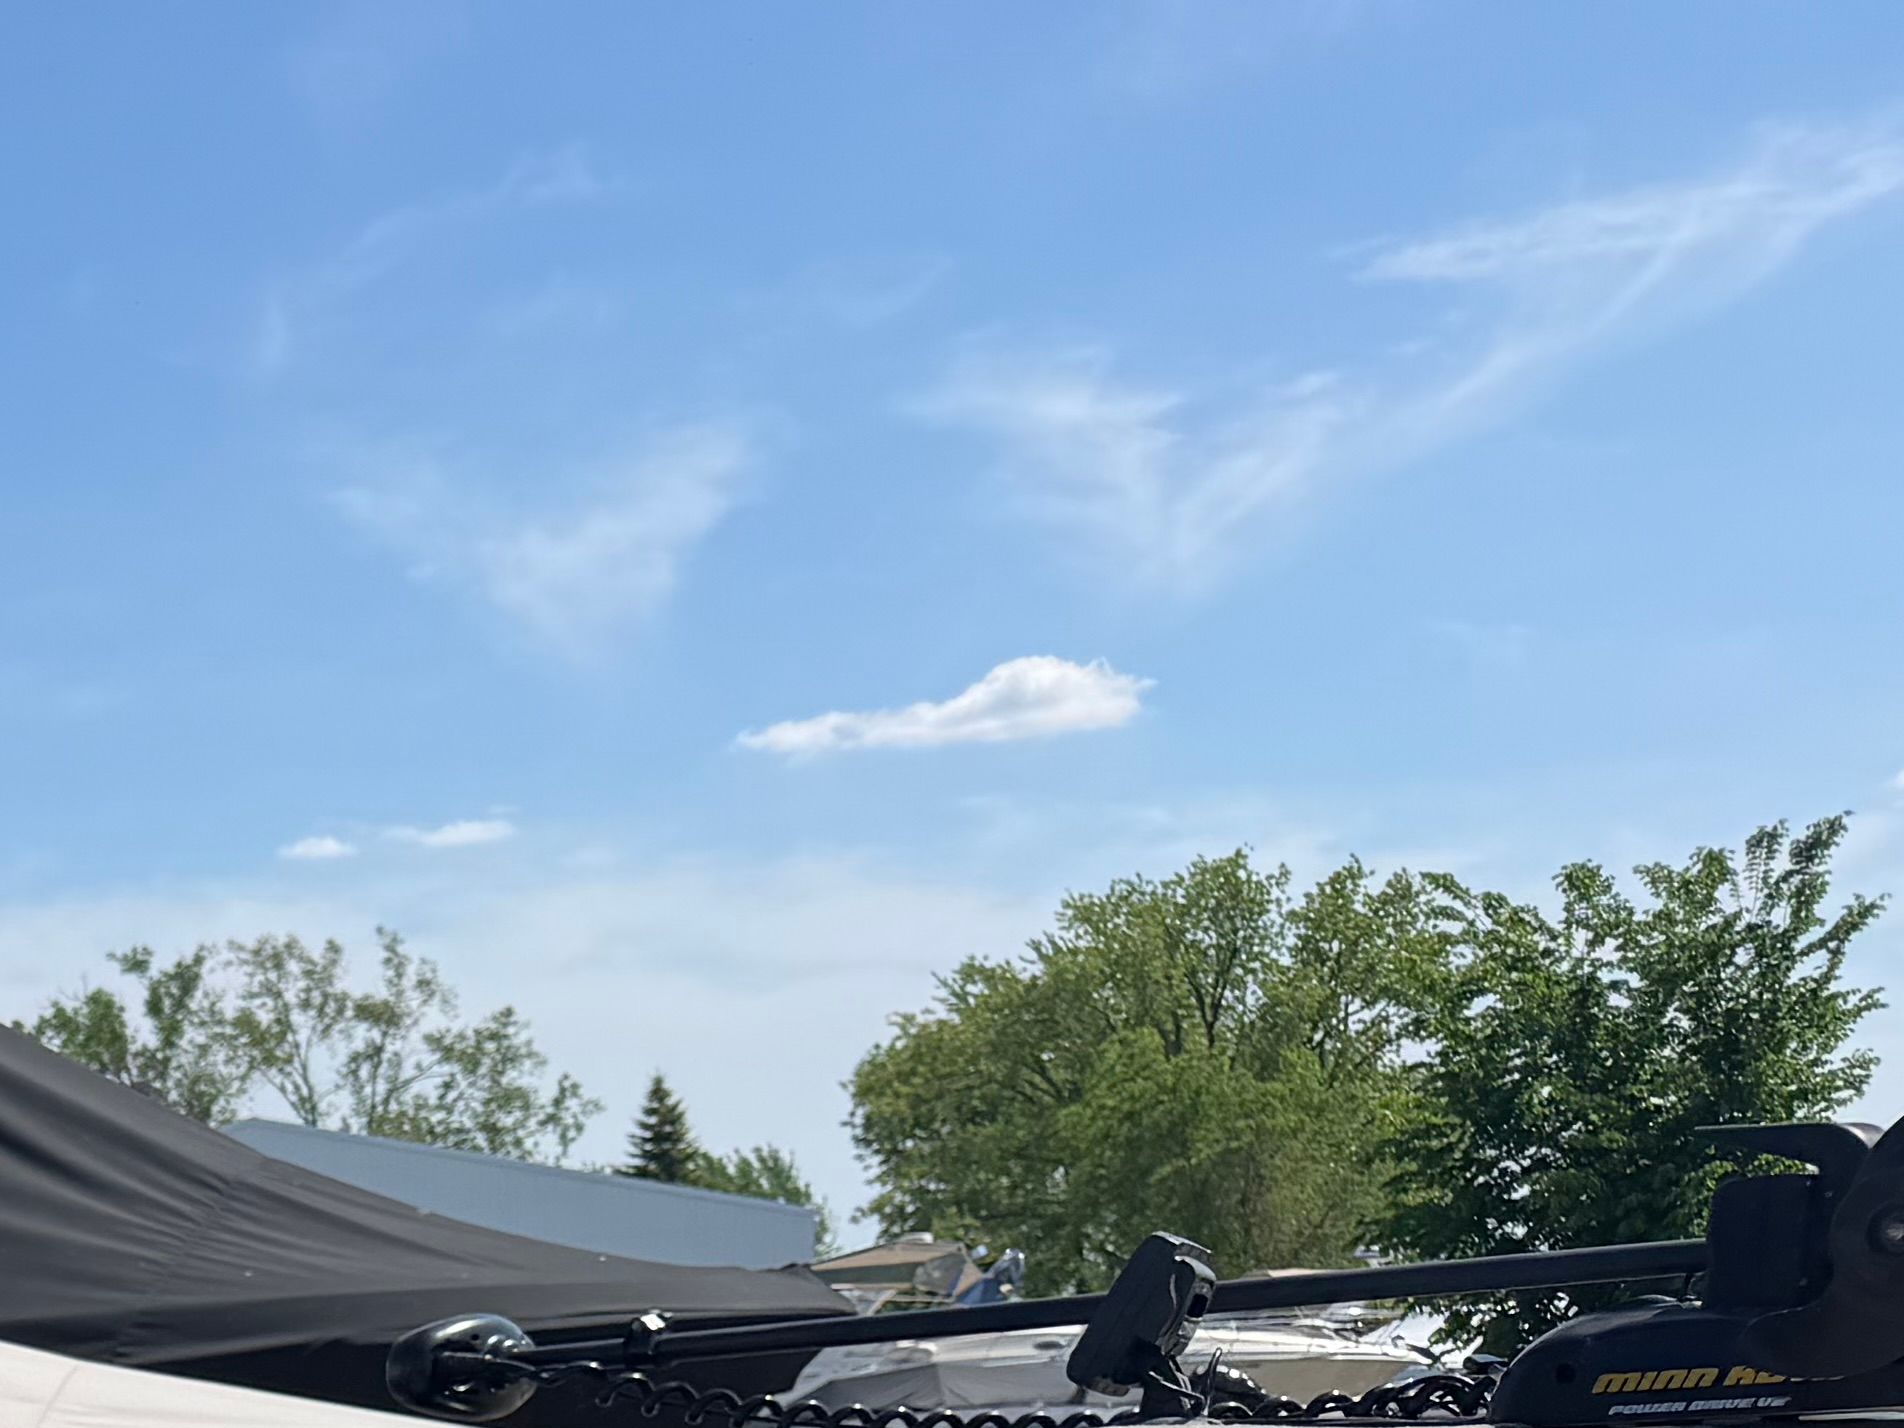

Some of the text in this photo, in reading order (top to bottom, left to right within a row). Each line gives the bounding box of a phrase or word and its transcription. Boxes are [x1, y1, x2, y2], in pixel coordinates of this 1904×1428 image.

[1592, 1367, 1720, 1394] MINN
[1608, 1402, 1687, 1416] POWER
[1688, 1399, 1757, 1412] DRIVE
